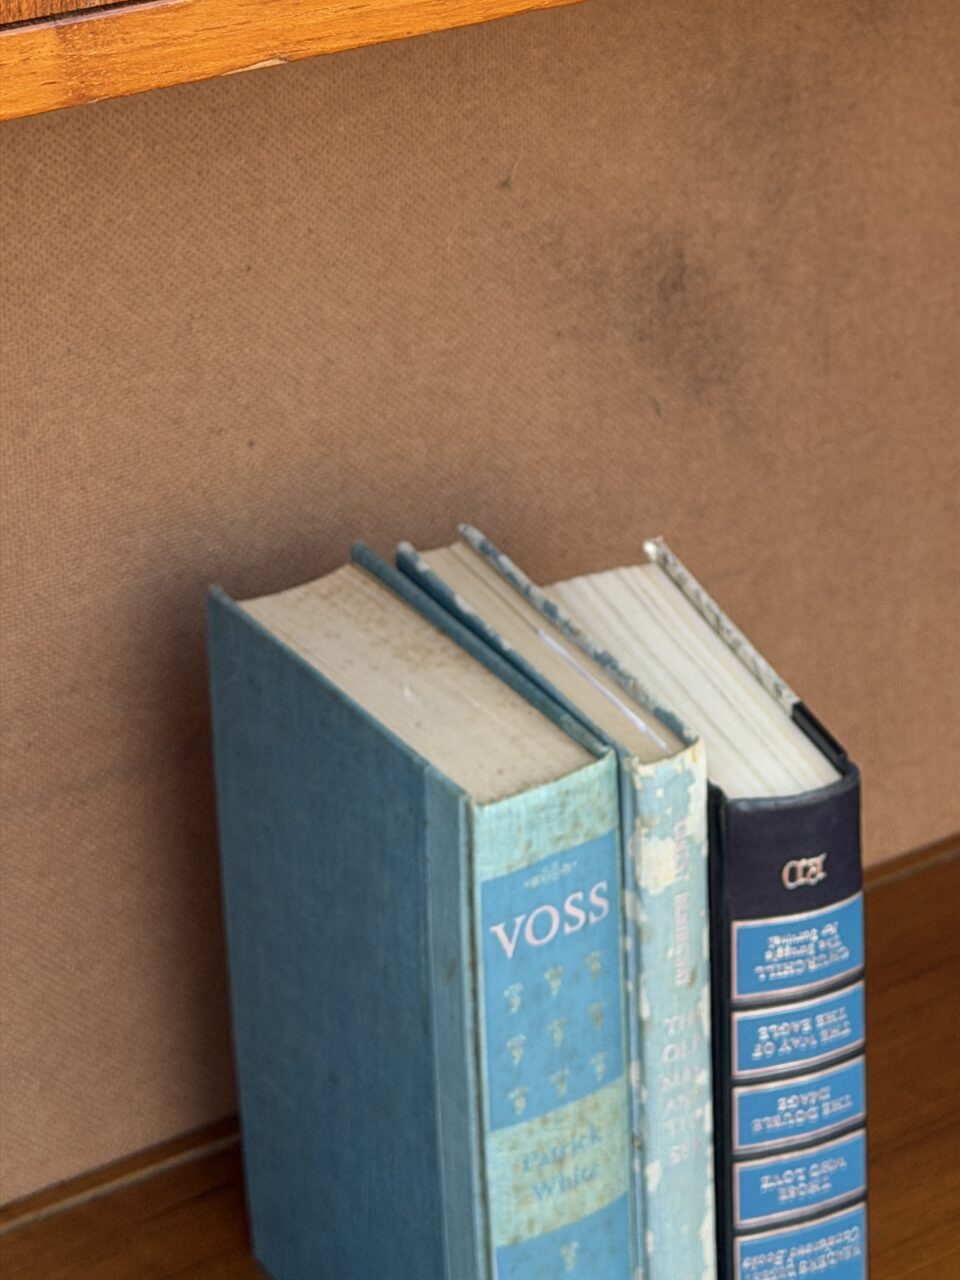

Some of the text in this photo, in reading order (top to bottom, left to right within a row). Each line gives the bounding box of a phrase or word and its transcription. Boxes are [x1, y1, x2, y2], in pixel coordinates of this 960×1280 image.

[490, 880, 610, 959] VOSS
[754, 945, 850, 982] CHURCHILL
[757, 1018, 812, 1041] EAGLE
[752, 1041, 776, 1061] OF
[778, 1035, 818, 1056] WAY
[751, 1107, 819, 1132] DOUBLE
